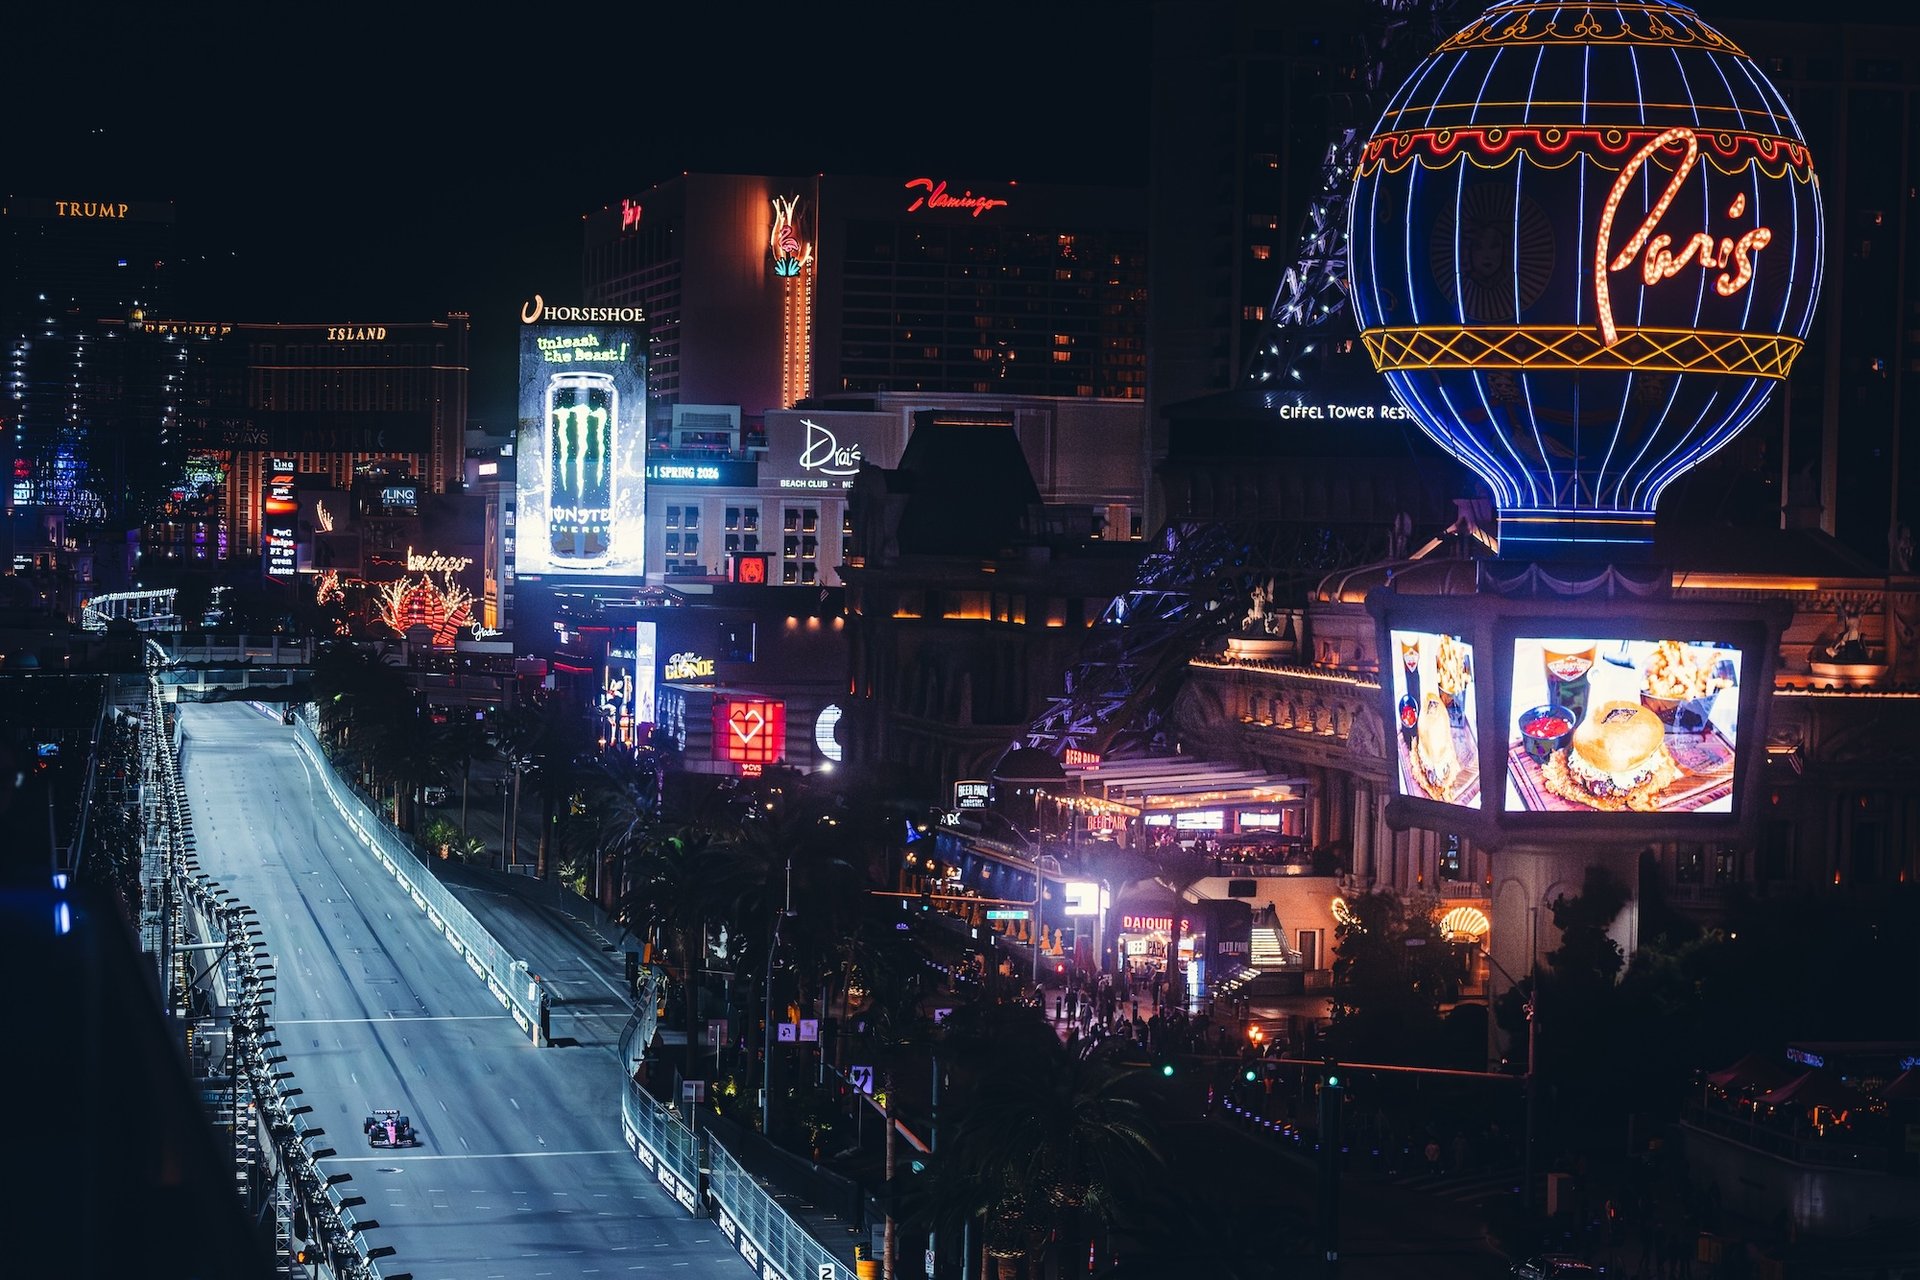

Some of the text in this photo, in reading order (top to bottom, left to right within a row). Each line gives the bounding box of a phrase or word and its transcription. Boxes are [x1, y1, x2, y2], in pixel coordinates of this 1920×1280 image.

[904, 178, 1008, 218] Flamingo
[55, 201, 129, 219] TRUMP
[1595, 127, 1772, 348] Paris
[543, 306, 645, 322] HORSESHOE
[327, 327, 387, 341] ISLAND
[537, 333, 600, 351] Unleash
[544, 348, 573, 363] the
[1280, 405, 1325, 419] EIFFEL
[1327, 405, 1375, 419] TOWER
[660, 466, 695, 478] SPRING
[780, 479, 828, 488] BEACH CLUB
[547, 505, 613, 525] ONSTE
[272, 528, 292, 536] PwC
[270, 539, 294, 547] helps
[269, 567, 295, 575] faster
[959, 785, 988, 797] BEER PARK
[1123, 916, 1189, 931] DAIQUIRS
[822, 1268, 832, 1280] 2
